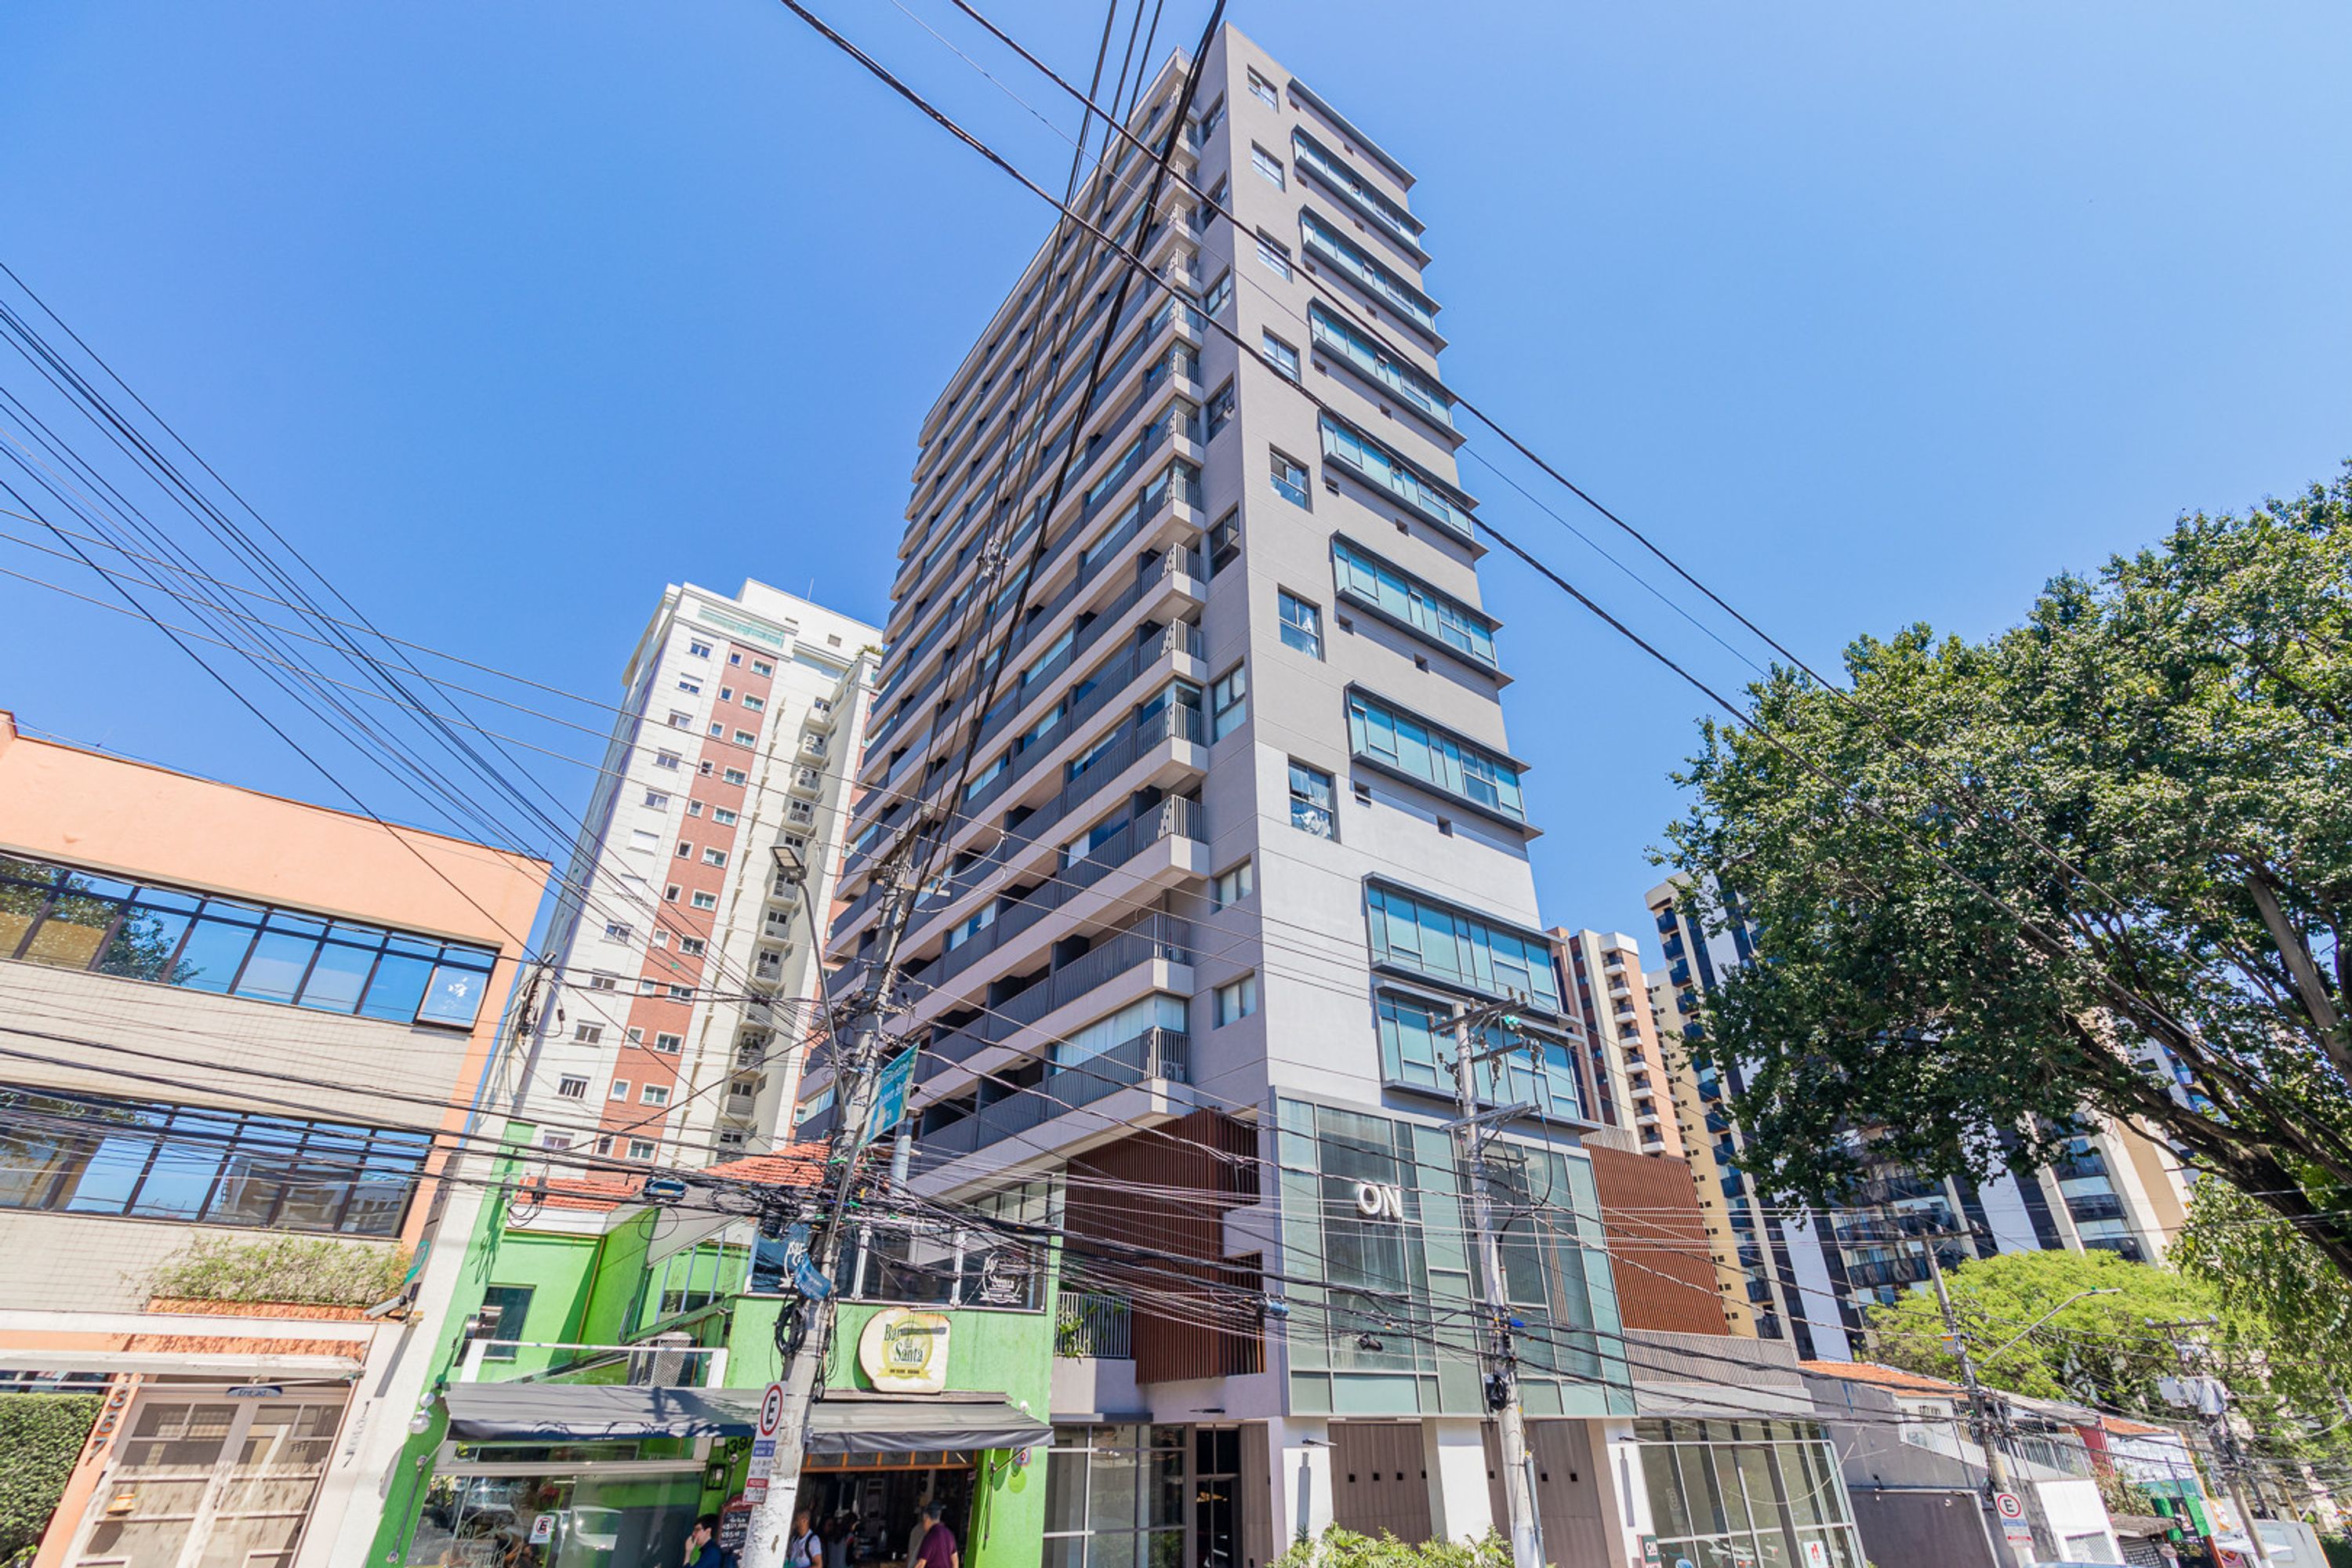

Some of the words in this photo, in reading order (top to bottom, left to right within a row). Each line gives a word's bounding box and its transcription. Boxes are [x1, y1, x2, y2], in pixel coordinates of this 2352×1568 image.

[1356, 1184, 1402, 1218] ON
[884, 1324, 902, 1341] Bar
[894, 1341, 924, 1363] Santa
[85, 1376, 129, 1463] 387
[766, 1396, 777, 1425] E
[2004, 1499, 2015, 1512] E
